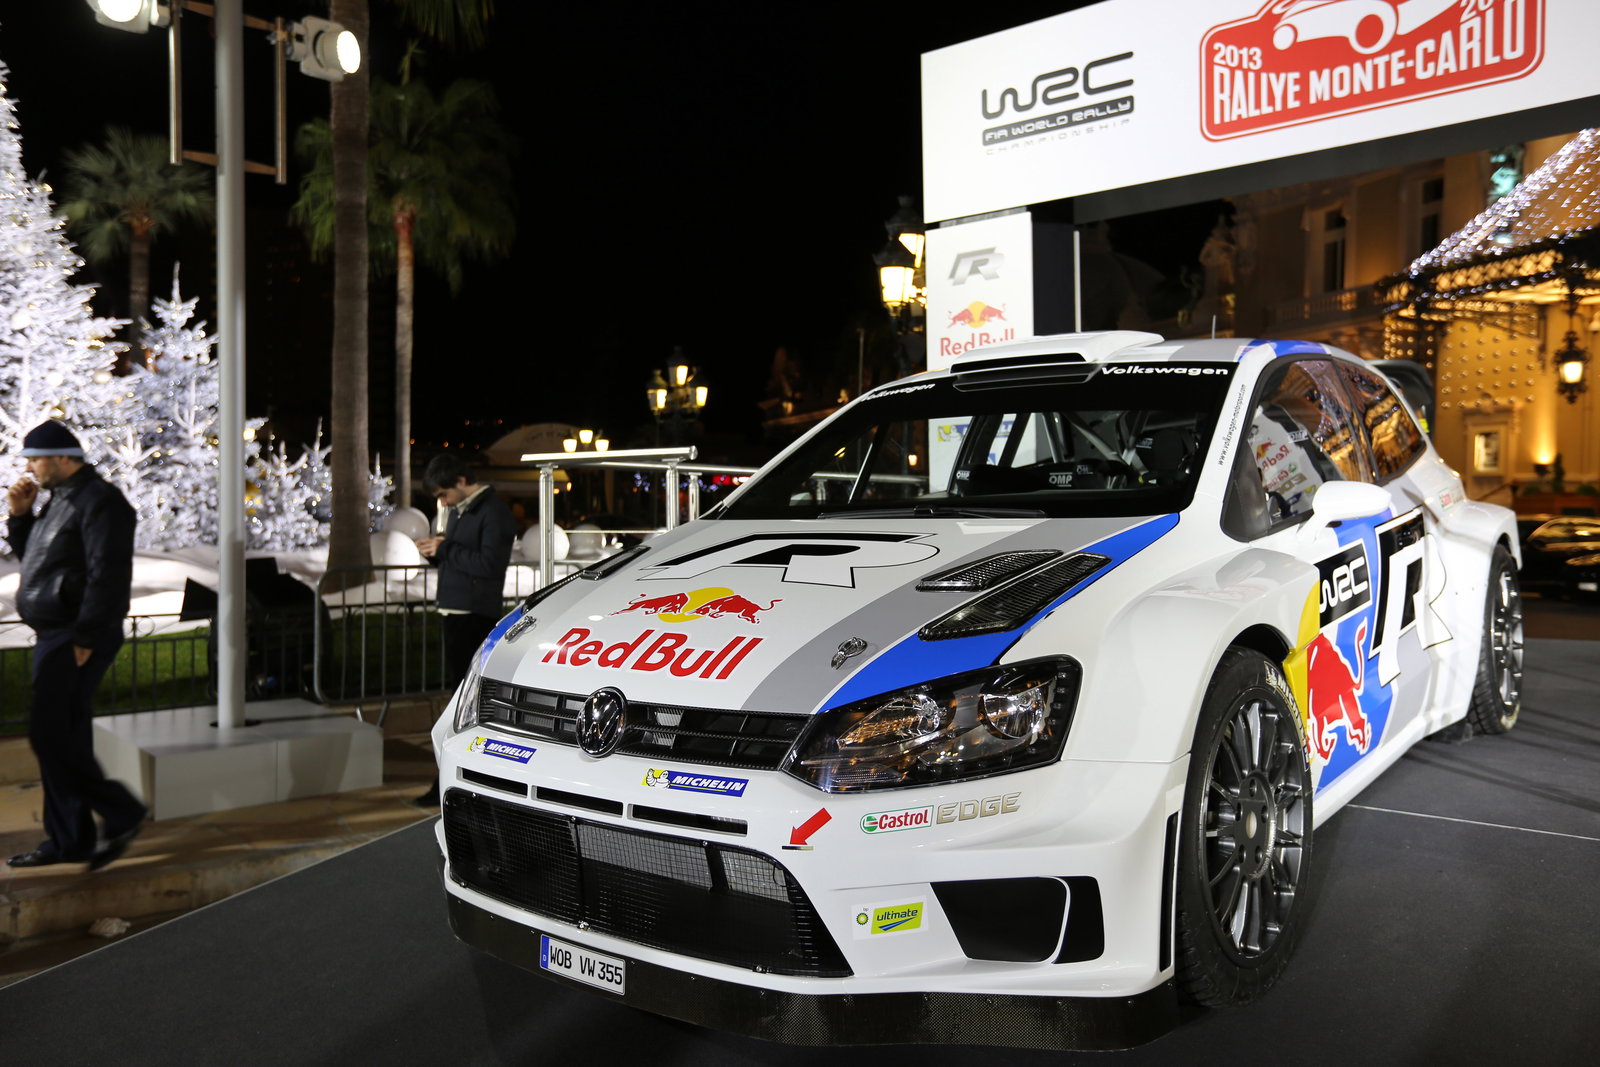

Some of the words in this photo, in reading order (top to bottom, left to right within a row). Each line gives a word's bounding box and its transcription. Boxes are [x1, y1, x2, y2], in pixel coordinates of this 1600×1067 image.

[1213, 42, 1263, 70] 2013
[1213, 64, 1300, 125] RALLYE
[1309, 0, 1526, 104] MONTE-CARLO
[982, 51, 1134, 120] WRC
[985, 129, 1008, 142] FIA
[1011, 115, 1069, 136] WORLD
[1072, 100, 1131, 122] RALLY
[940, 333, 975, 357] Red
[1101, 365, 1229, 376] Volkswagen
[1048, 475, 1073, 484] OMP
[541, 627, 655, 669] Red
[631, 630, 763, 680] Bull
[486, 742, 533, 760] MICHELIN
[671, 775, 745, 792] MICHELIN
[878, 809, 929, 830] Castrol
[936, 791, 1022, 825] EDGE
[876, 908, 919, 922] ultimate
[550, 945, 572, 970] WOB
[580, 955, 596, 978] VW
[598, 961, 623, 986] 355
